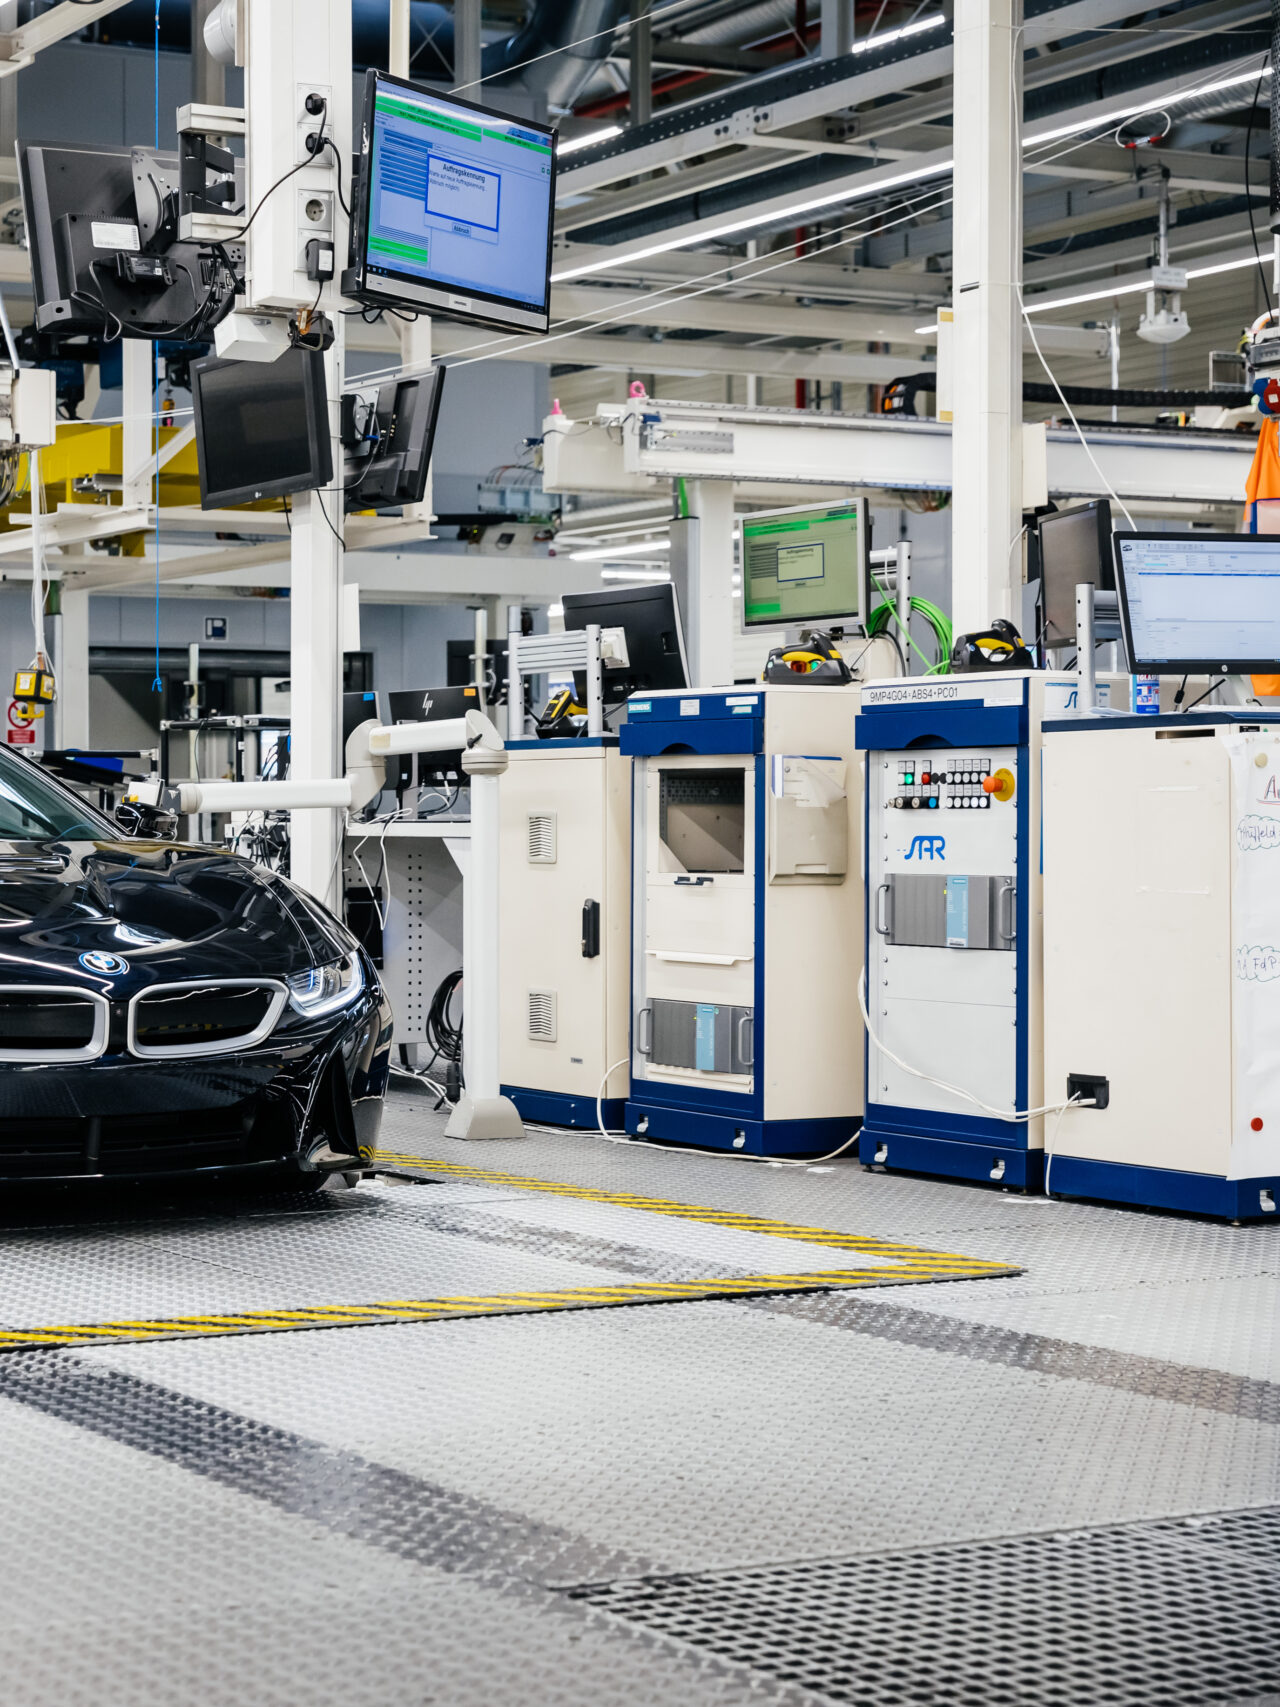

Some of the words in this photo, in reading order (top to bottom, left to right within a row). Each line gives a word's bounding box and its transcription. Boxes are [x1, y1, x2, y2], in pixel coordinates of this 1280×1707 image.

[443, 164, 486, 184] Auftragskennung
[422, 692, 433, 716] hp
[904, 835, 946, 861] SAR
